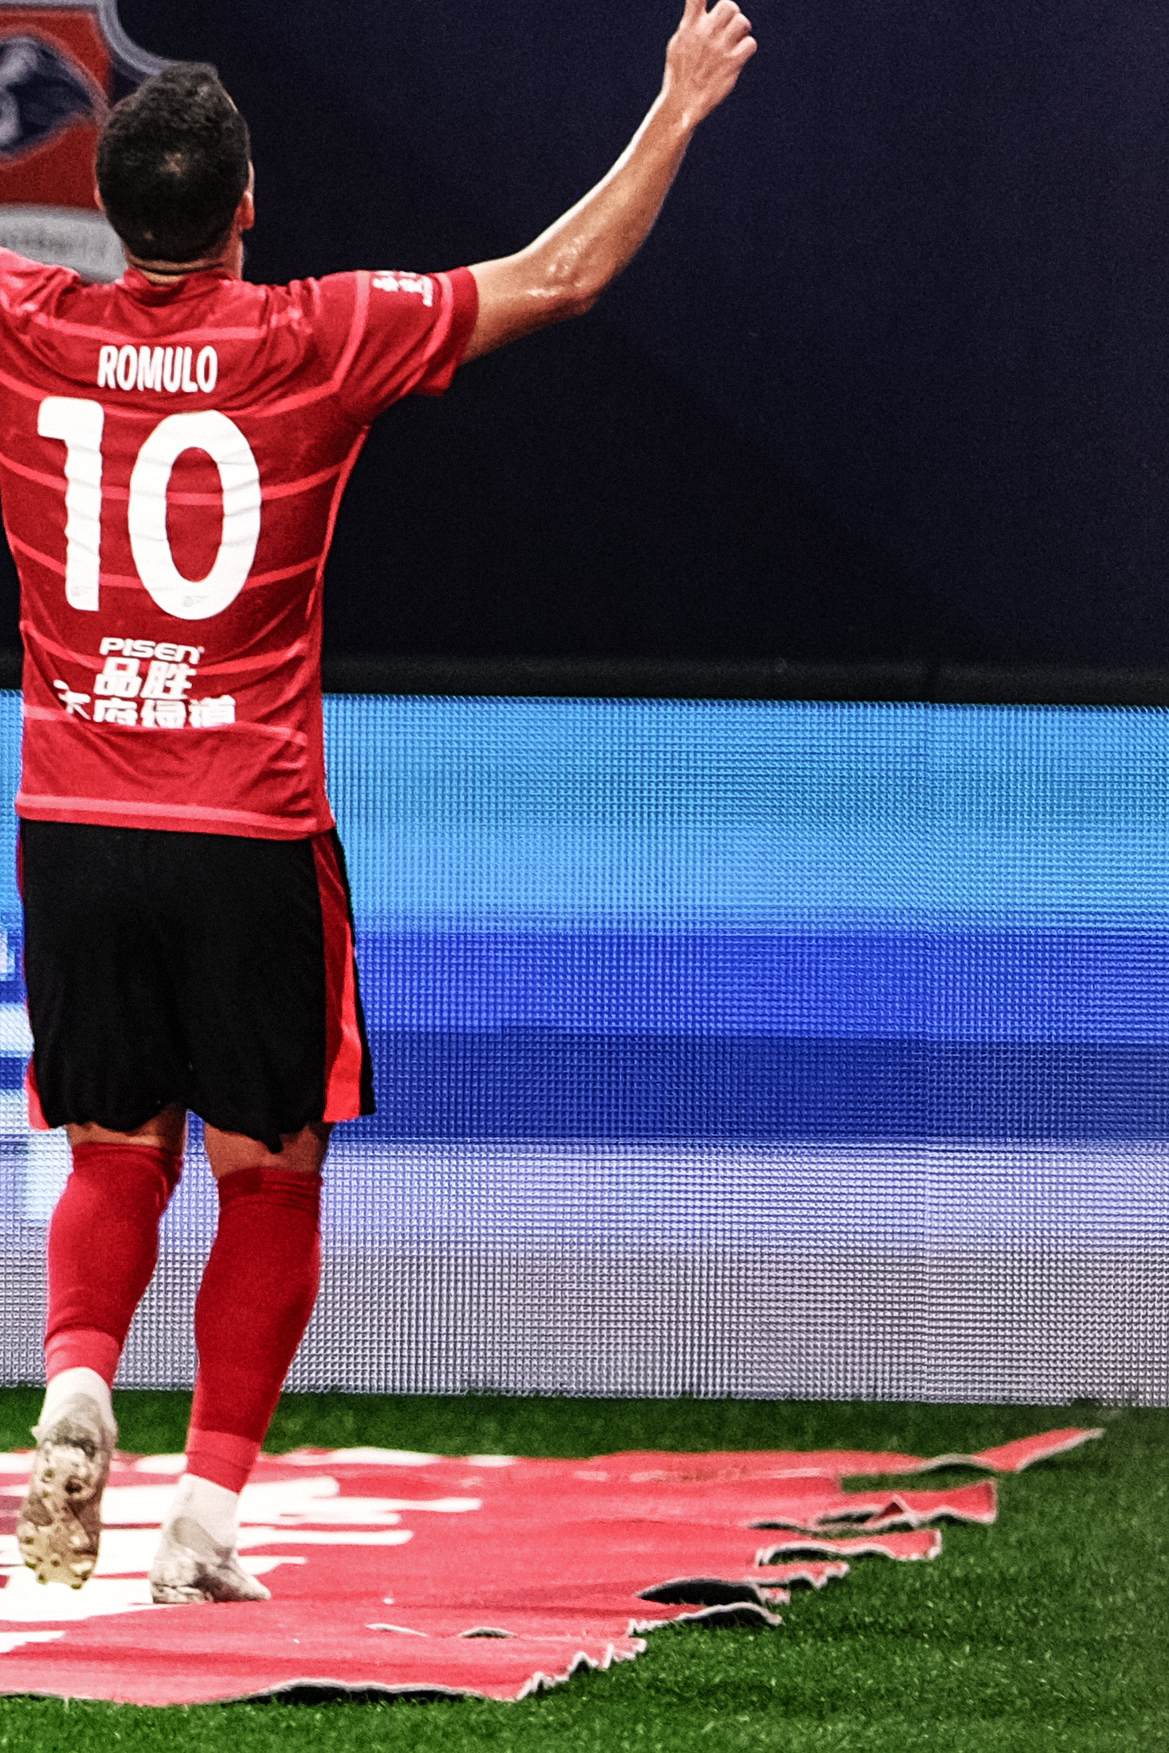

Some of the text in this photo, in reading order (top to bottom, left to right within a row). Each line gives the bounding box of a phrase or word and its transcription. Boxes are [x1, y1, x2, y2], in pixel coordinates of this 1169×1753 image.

[97, 344, 219, 394] ROMULO
[37, 395, 262, 620] 10
[93, 656, 197, 700] 品胜
